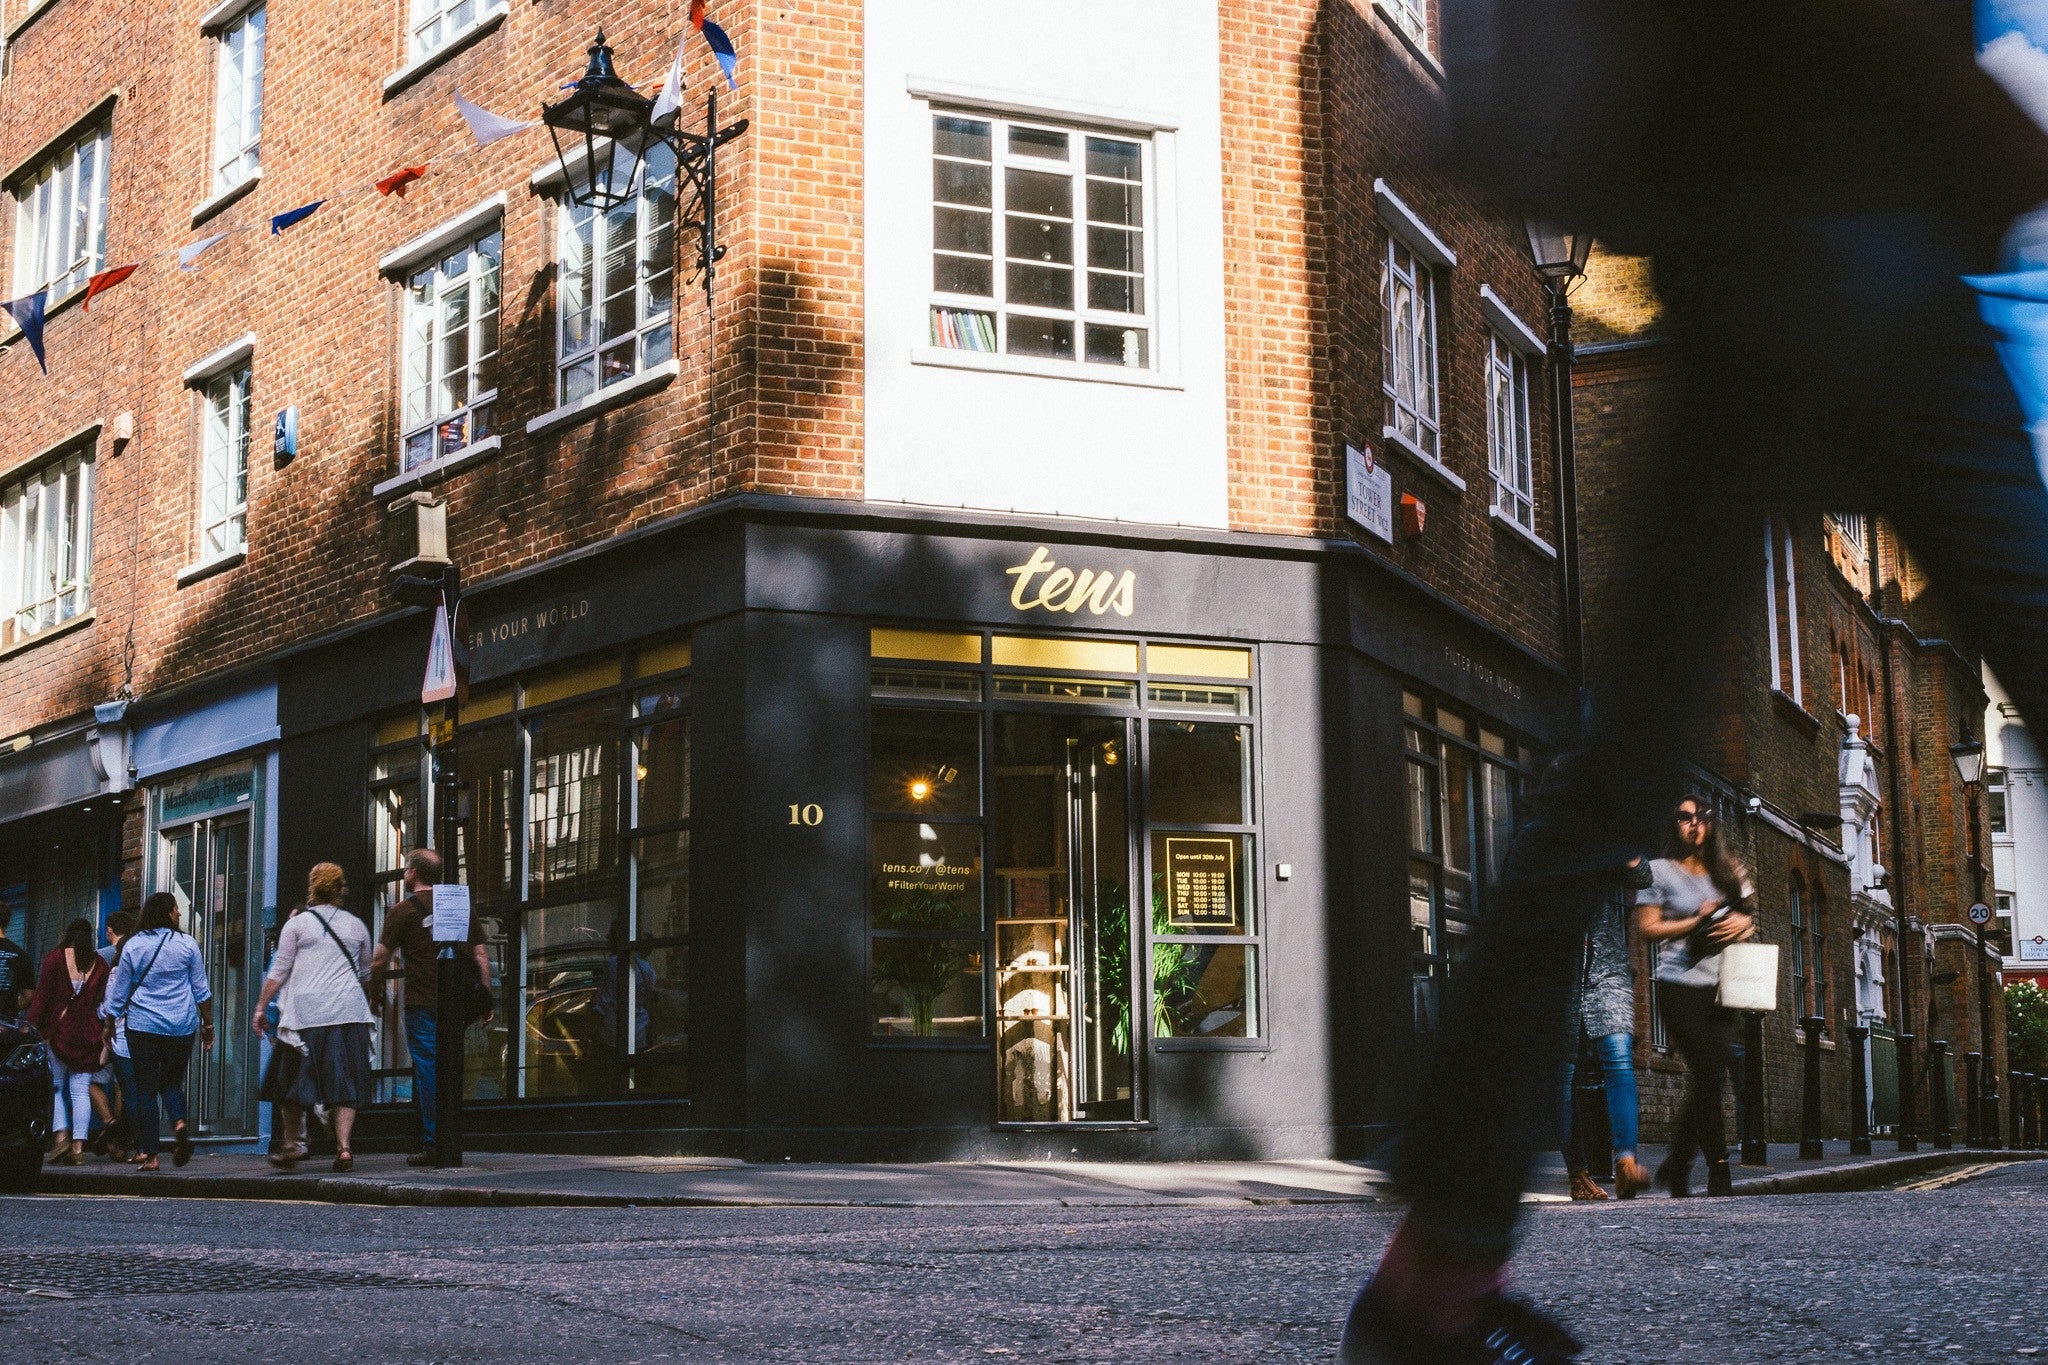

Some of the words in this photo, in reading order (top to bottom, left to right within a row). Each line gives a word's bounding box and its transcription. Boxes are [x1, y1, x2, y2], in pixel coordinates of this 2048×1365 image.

[1351, 495, 1376, 523] STREET
[1358, 481, 1381, 509] TOWER
[1005, 546, 1136, 617] tens
[490, 617, 528, 644] YOUR
[536, 600, 589, 629] WORLD
[1445, 646, 1471, 674] FILTER
[1474, 662, 1493, 684] YOUR
[1496, 675, 1521, 700] WORLD
[788, 803, 824, 826] 10
[882, 862, 922, 874] tens.co
[935, 864, 970, 876] @tens
[888, 880, 965, 891] #FilterYourWorld
[1970, 908, 1988, 919] 20
